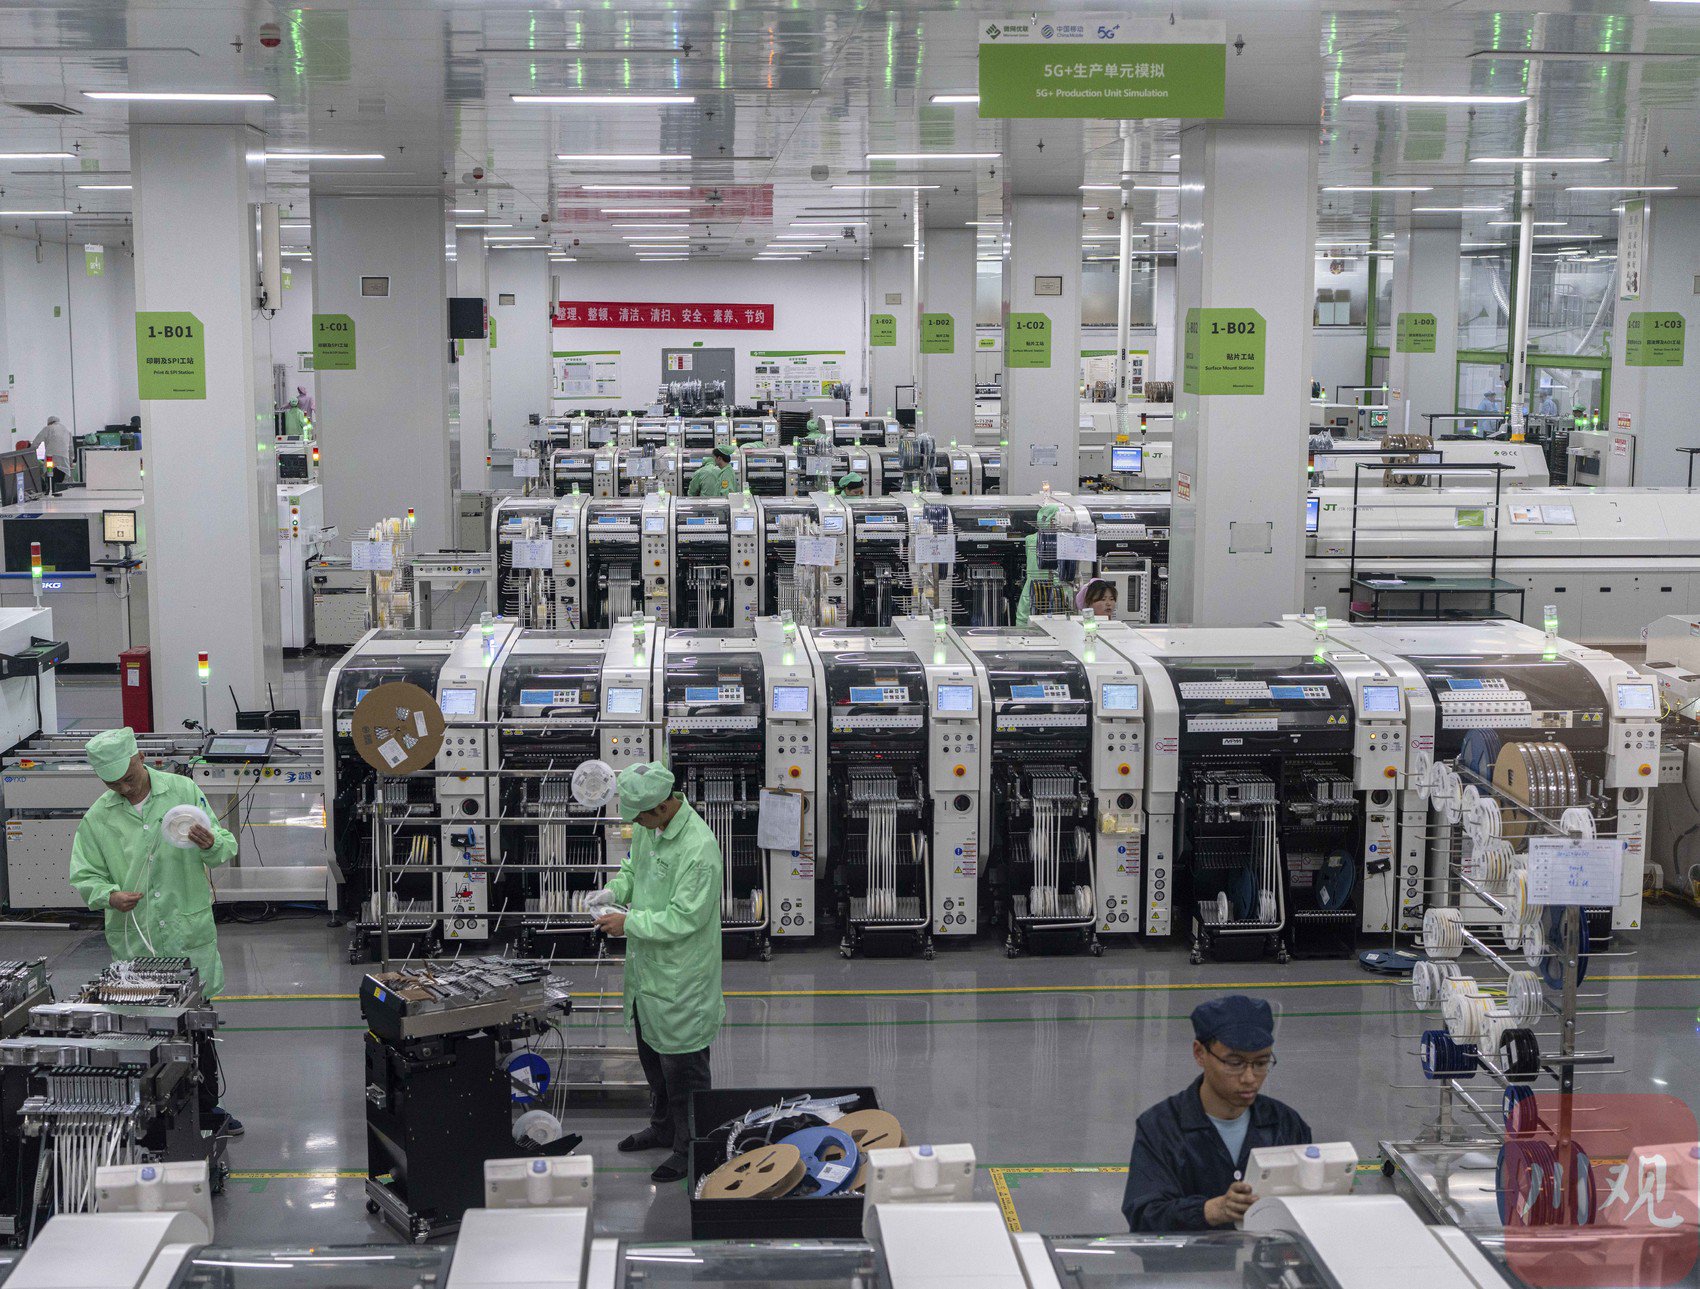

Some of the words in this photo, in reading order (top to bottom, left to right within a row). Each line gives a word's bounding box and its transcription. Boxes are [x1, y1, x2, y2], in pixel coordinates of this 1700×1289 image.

[1044, 63, 1165, 78] 5G+生产单元模拟
[1036, 88, 1053, 97] 5G+
[1056, 88, 1102, 97] Production
[1104, 88, 1122, 97] Unit
[1124, 88, 1168, 97] Simulation
[148, 326, 193, 338] 1-B01
[320, 323, 348, 331] 1-C01
[1212, 322, 1255, 334] 1-B02
